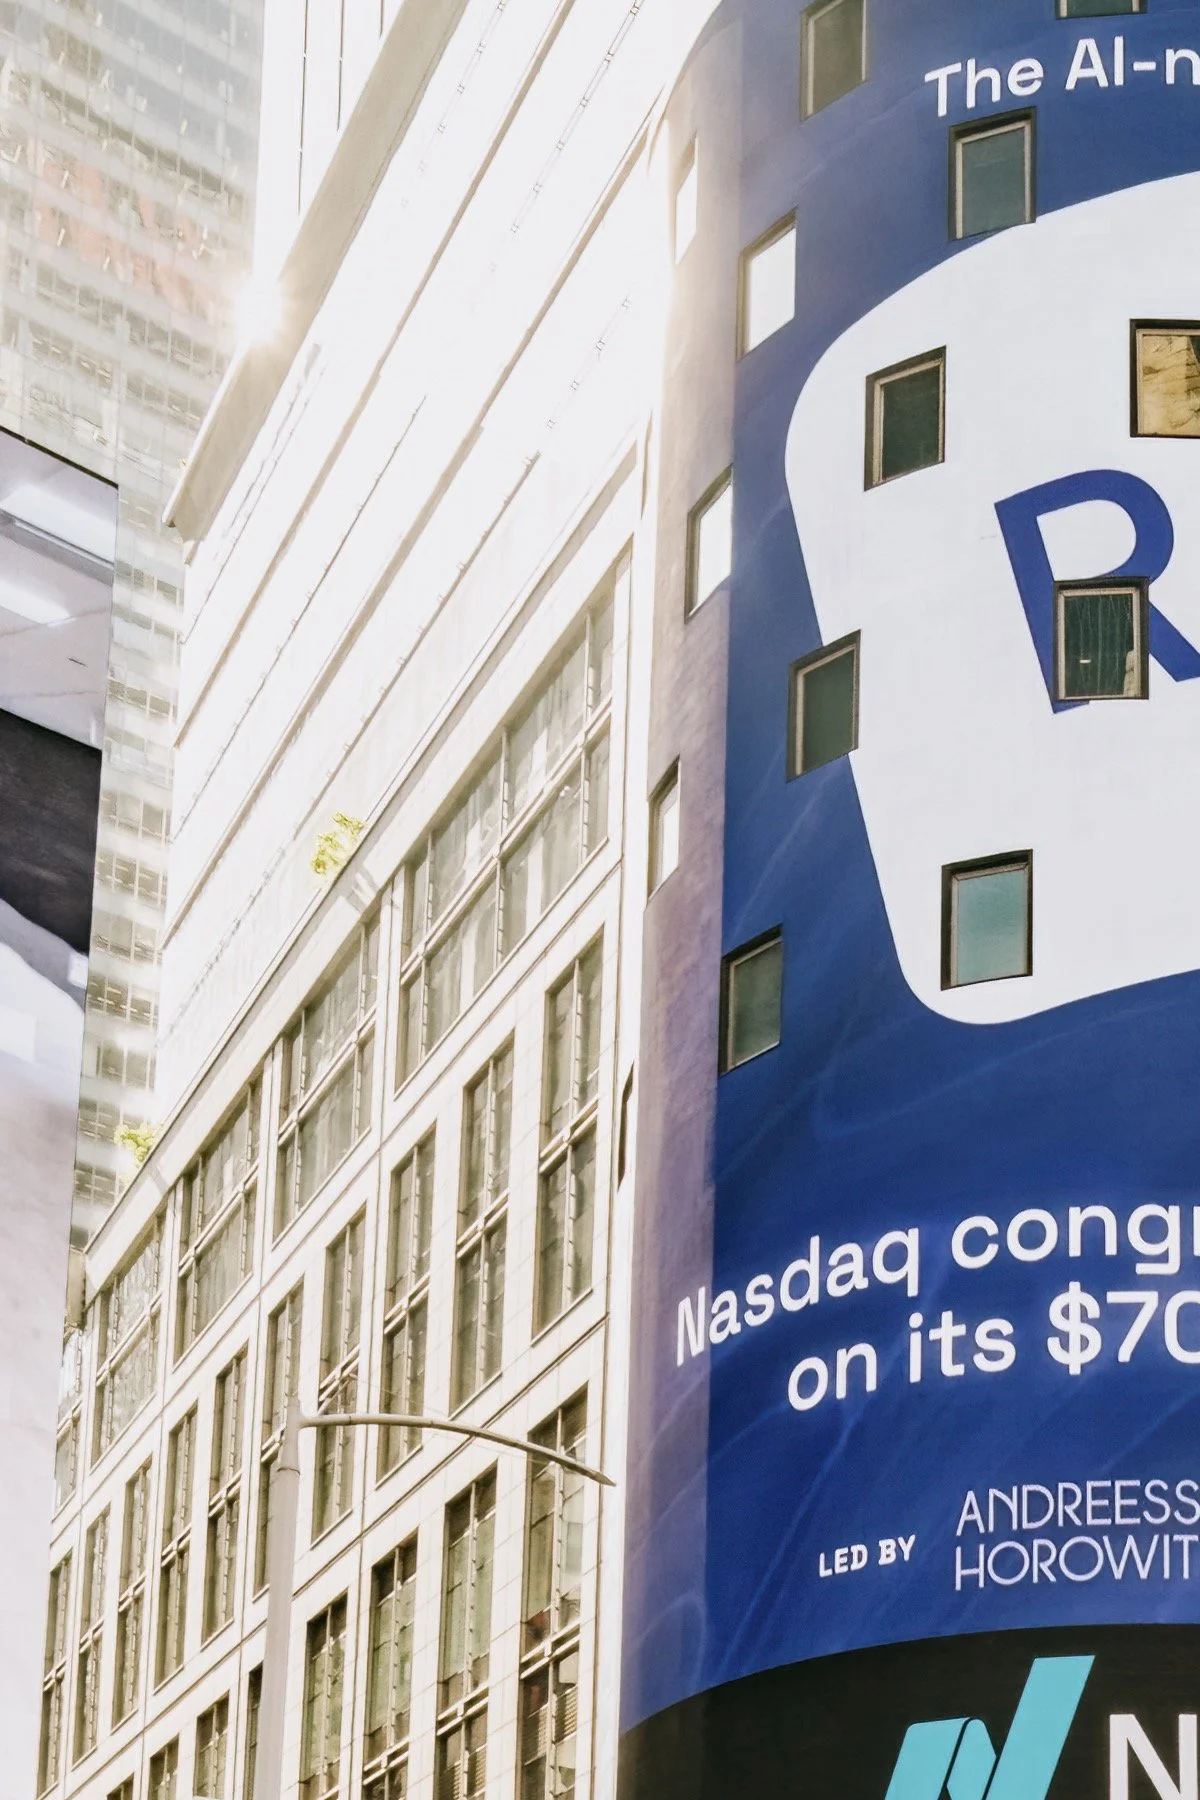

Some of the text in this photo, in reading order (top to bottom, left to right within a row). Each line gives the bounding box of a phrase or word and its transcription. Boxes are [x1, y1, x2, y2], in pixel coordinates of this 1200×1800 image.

[924, 57, 1044, 117] The
[676, 1227, 920, 1367] Nasdaq
[787, 1342, 877, 1411] on
[908, 1311, 1017, 1384] its
[818, 1534, 917, 1578] LED BY
